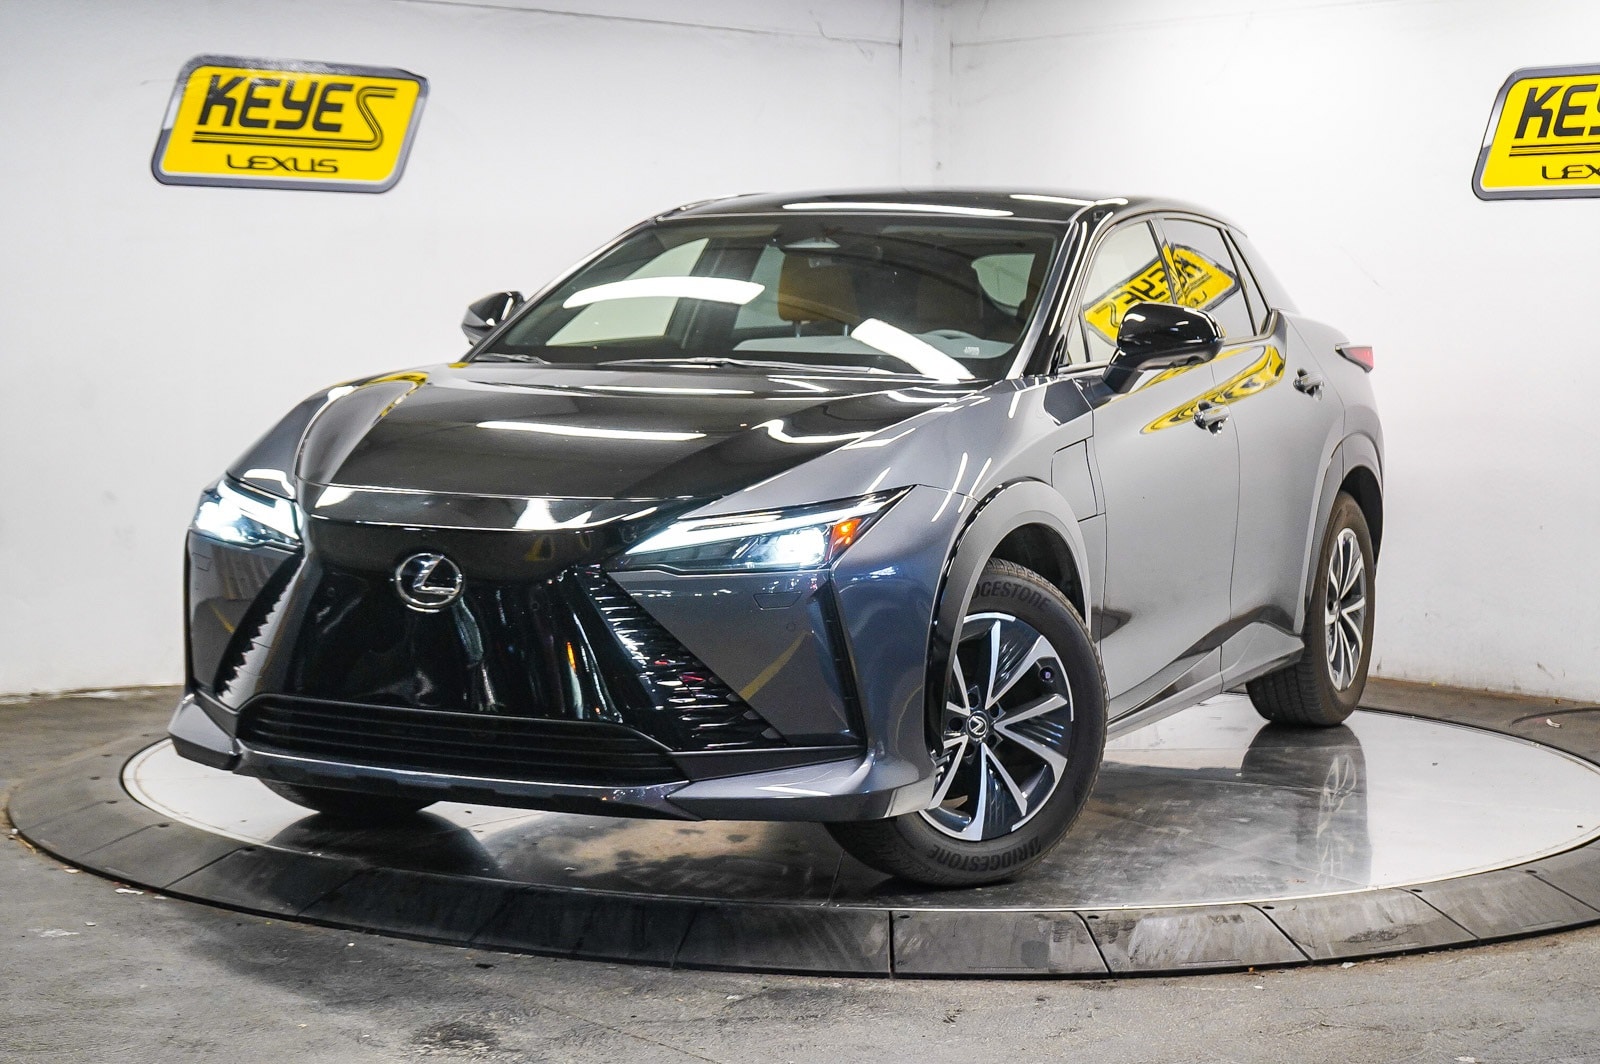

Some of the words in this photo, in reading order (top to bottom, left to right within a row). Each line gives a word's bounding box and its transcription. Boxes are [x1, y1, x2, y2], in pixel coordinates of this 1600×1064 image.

[195, 74, 398, 149] KEYES
[226, 154, 339, 173] LEXUS
[927, 836, 1042, 872] BRIDGESTONE
